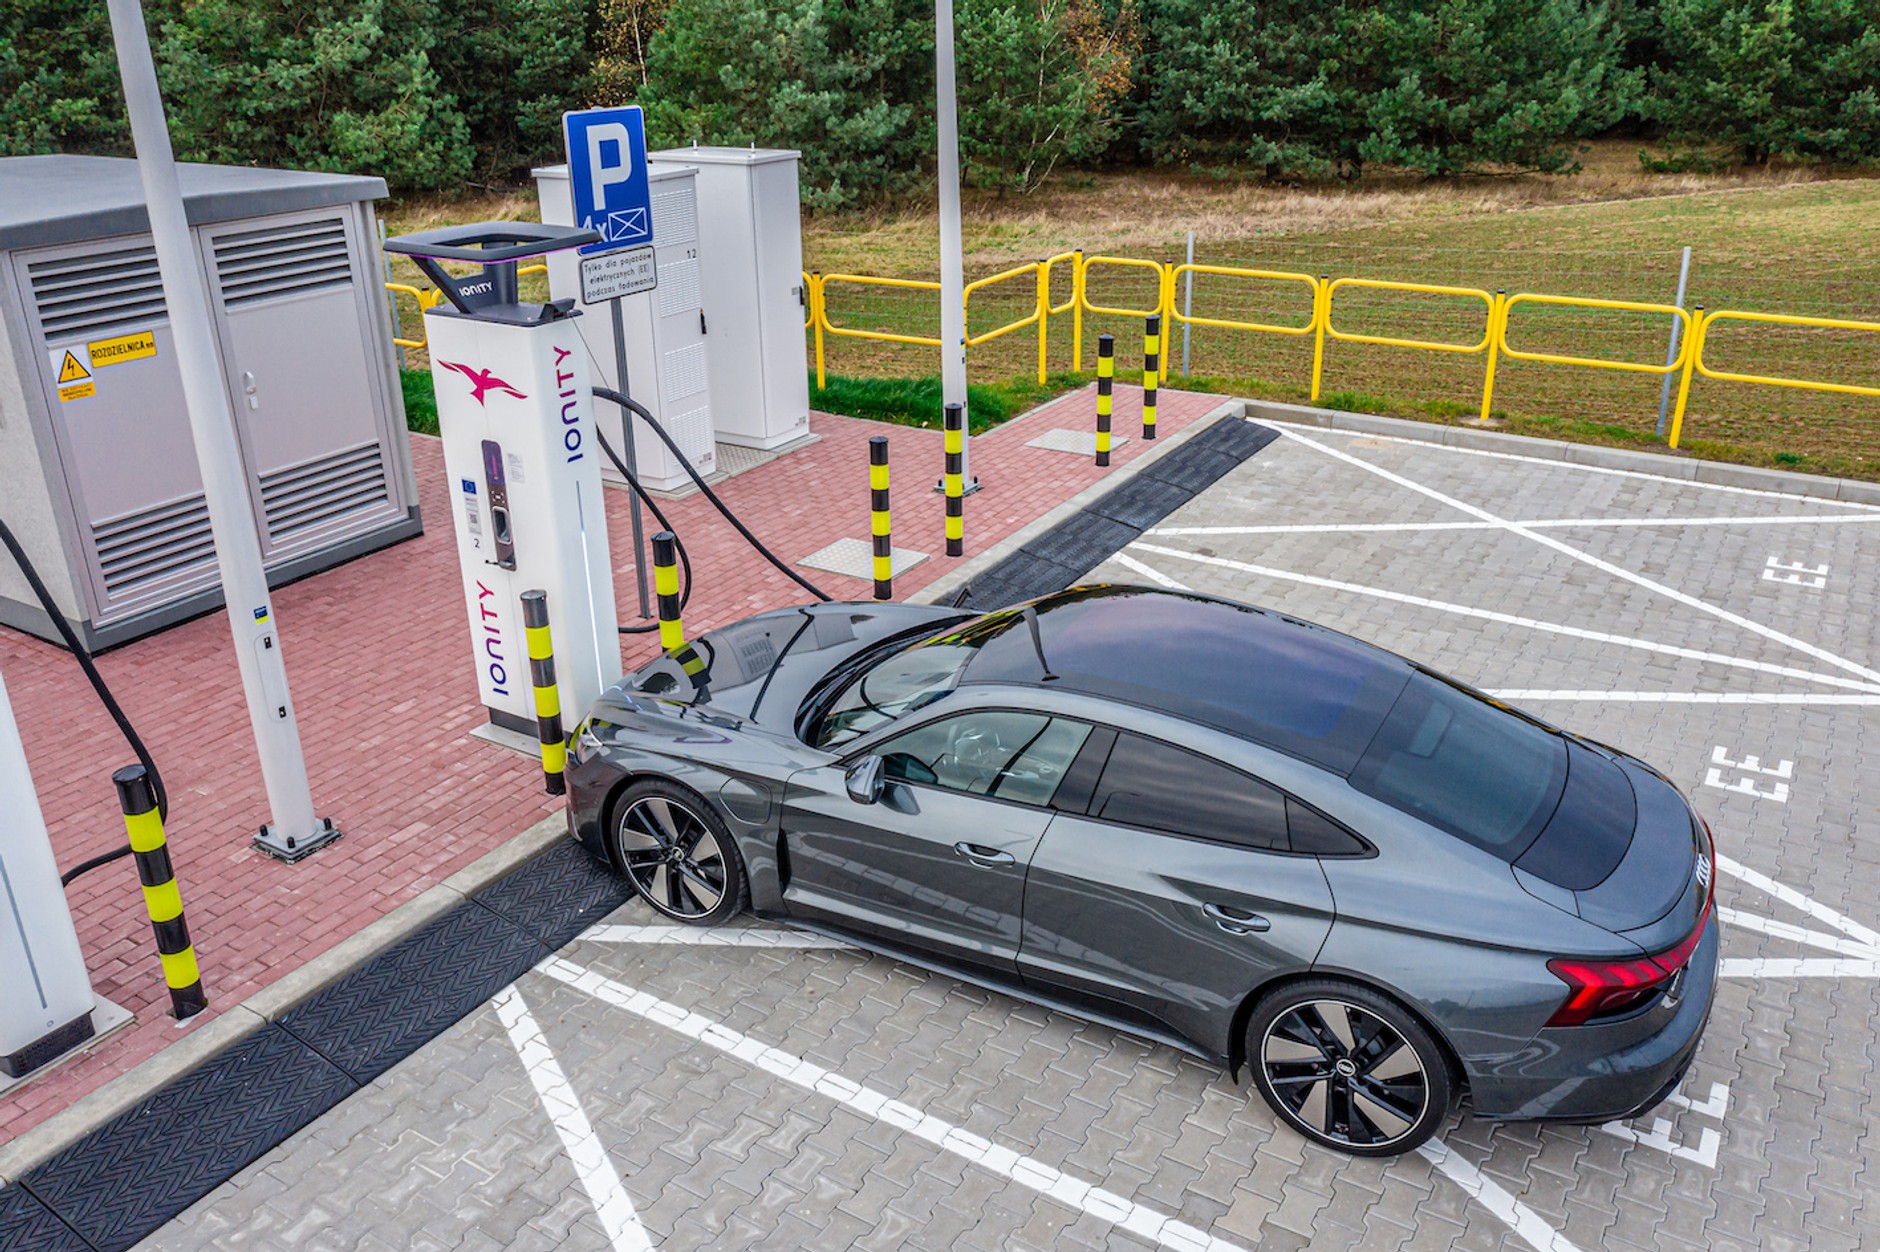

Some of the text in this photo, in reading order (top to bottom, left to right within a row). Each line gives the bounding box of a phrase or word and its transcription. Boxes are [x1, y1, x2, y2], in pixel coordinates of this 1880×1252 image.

[586, 122, 632, 211] P
[584, 252, 652, 274] Tylko dla pojazdów
[686, 248, 697, 259] 12
[590, 268, 635, 284] elektrycznych
[459, 281, 494, 297] IONITY
[586, 285, 616, 298] podczas
[91, 340, 145, 359] ROZDZIELNICA
[553, 345, 584, 463] IONITY
[473, 538, 481, 549] 2
[1762, 556, 1829, 589] EE
[476, 580, 509, 696] IONITY
[1704, 745, 1794, 804] EE
